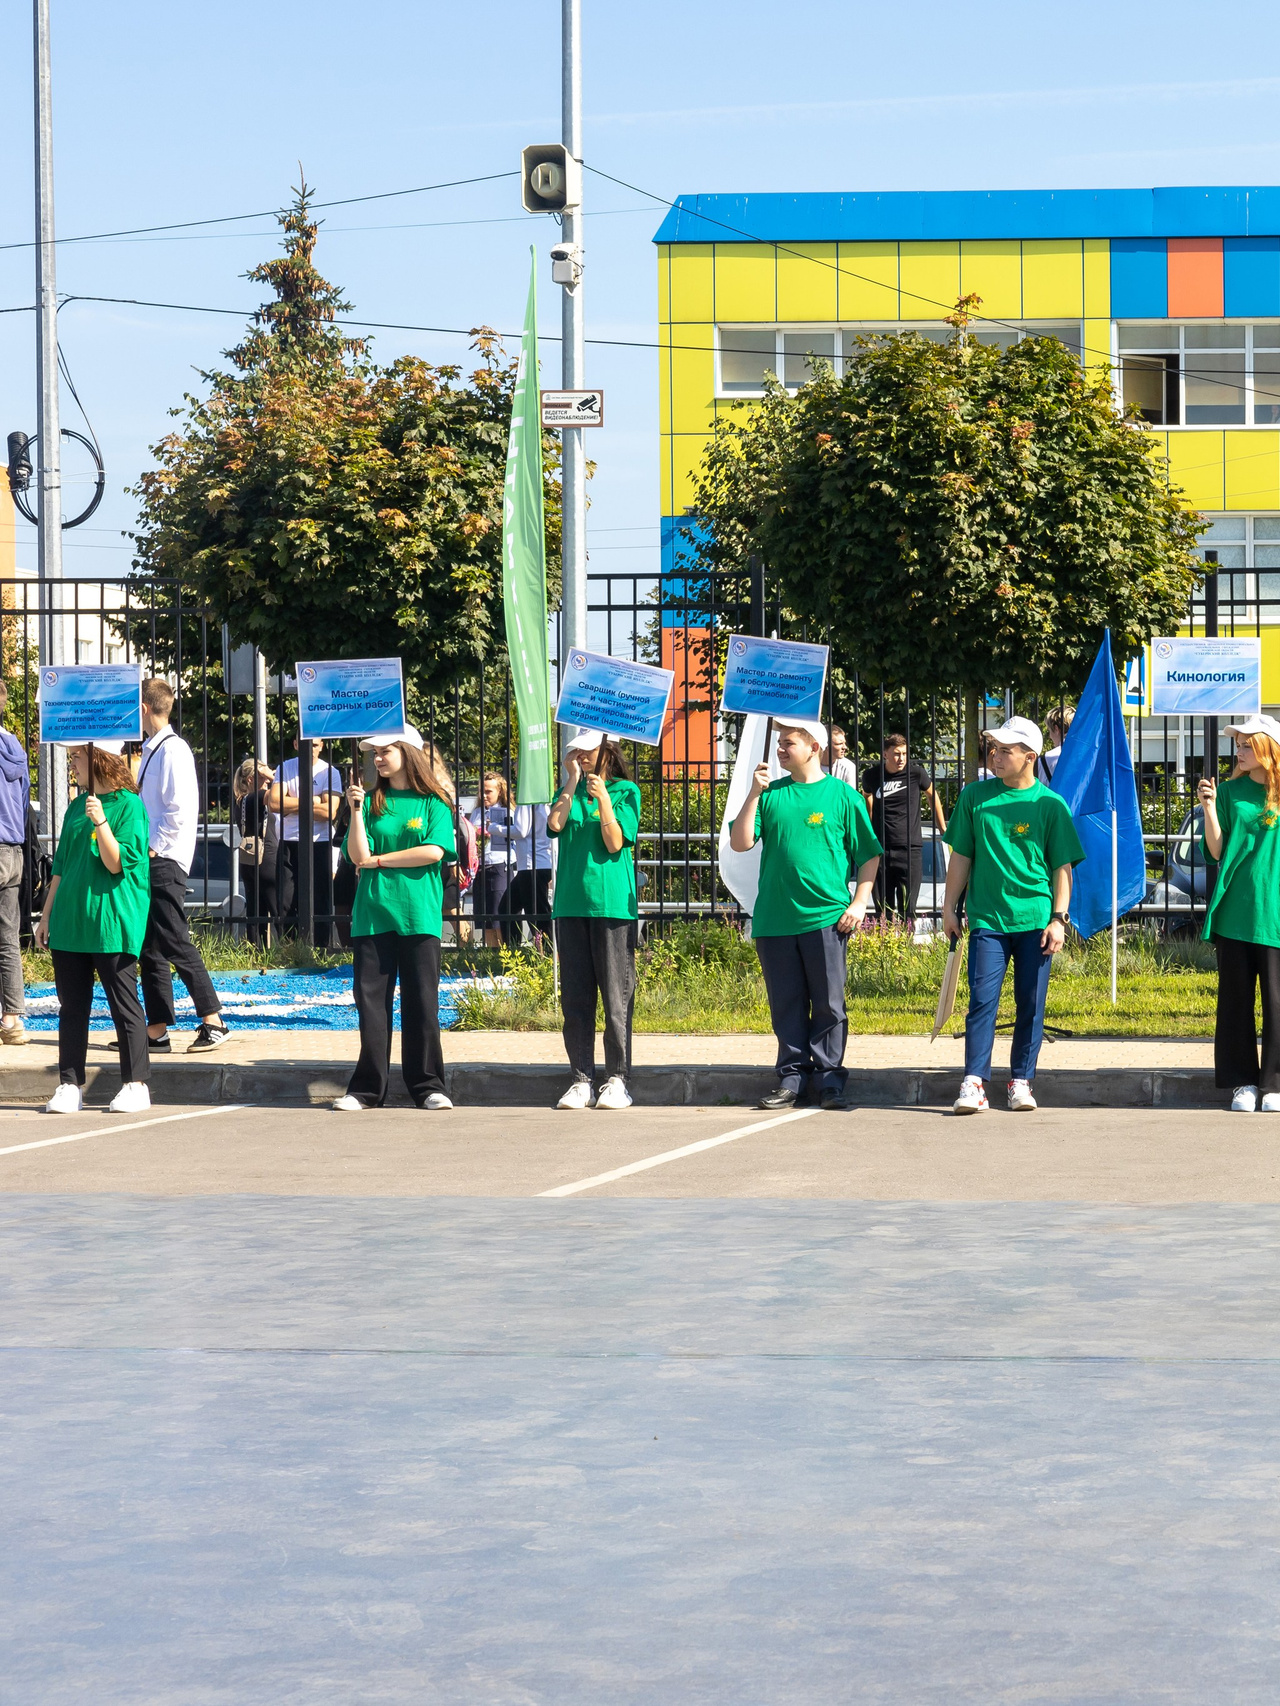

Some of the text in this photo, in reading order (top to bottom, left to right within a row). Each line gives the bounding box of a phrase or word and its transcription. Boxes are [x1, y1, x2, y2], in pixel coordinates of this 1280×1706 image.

[736, 666, 766, 677] Мастер
[780, 672, 812, 682] ремонту
[1166, 670, 1245, 682] Кинология
[748, 679, 806, 691] обслуживанию
[331, 690, 368, 698] Мастер
[578, 681, 650, 704] Сварщик (ручной
[748, 688, 798, 700] автомобилей
[86, 699, 136, 707] обслуживание
[308, 700, 394, 712] слесарных работ
[598, 697, 636, 710] частично
[570, 700, 650, 724] механизированной
[570, 710, 646, 733] сварки (наплавки)
